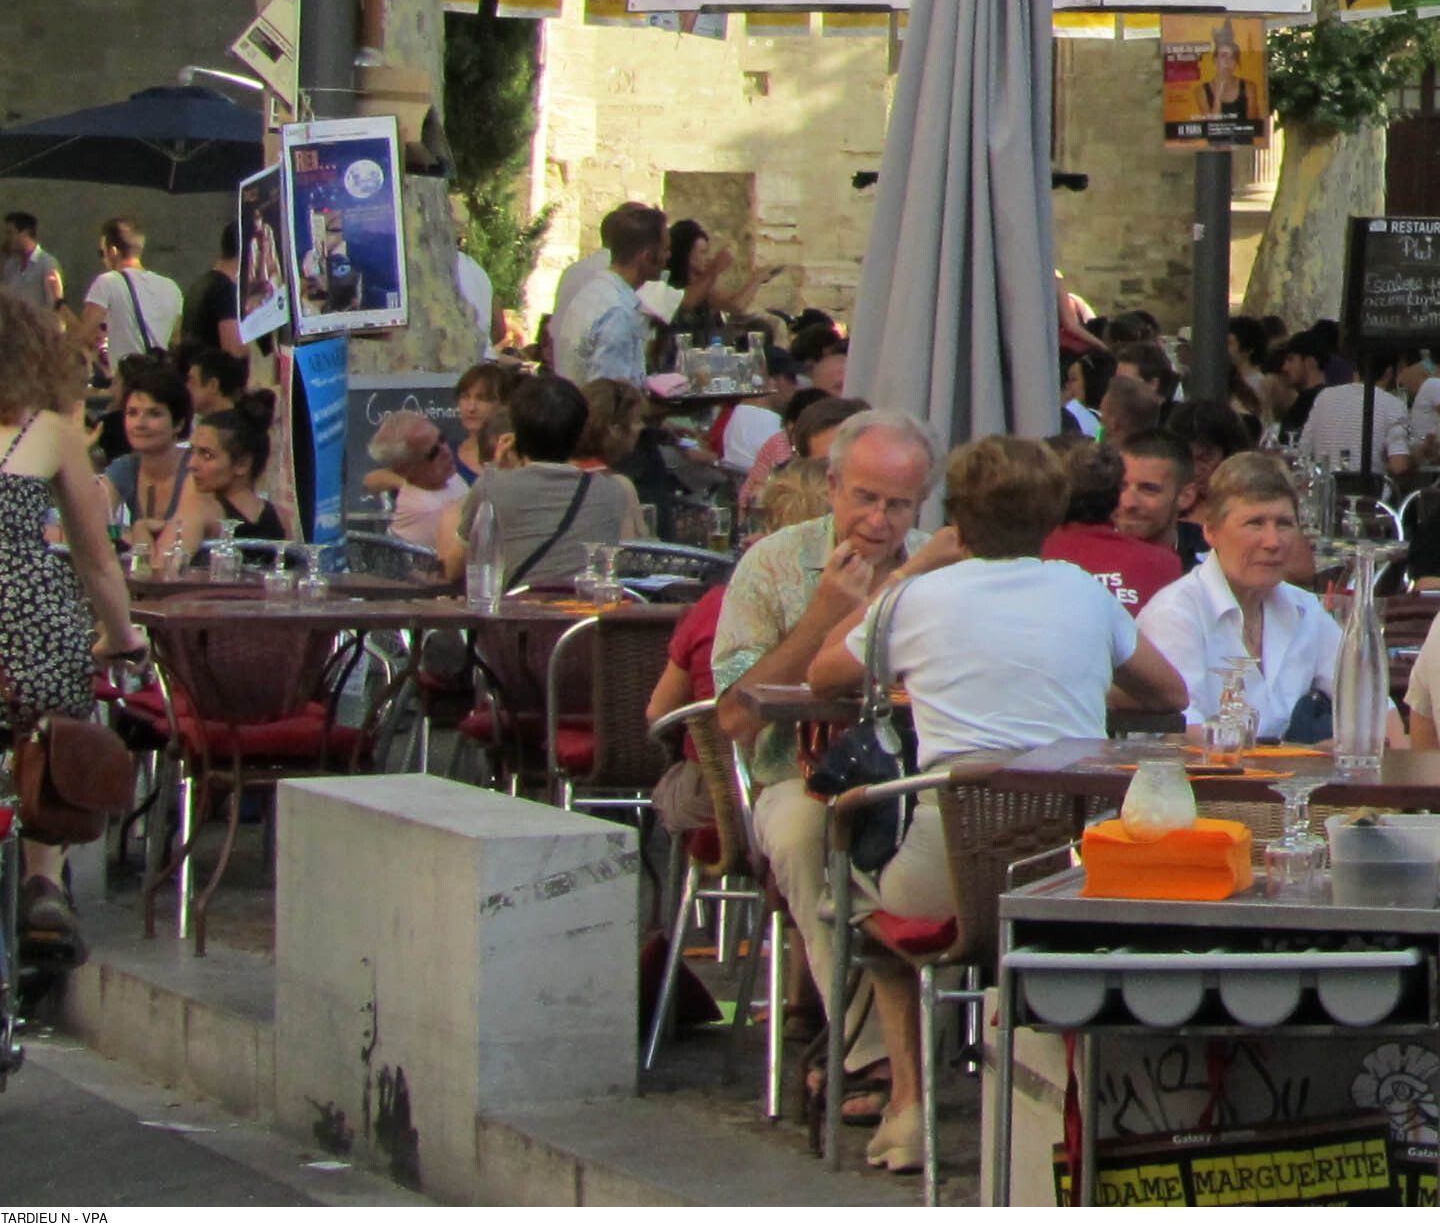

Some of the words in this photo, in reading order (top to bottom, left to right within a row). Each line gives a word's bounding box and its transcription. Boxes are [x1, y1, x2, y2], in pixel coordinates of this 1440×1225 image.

[1173, 1132, 1212, 1145] Galaxy
[1408, 1147, 1440, 1160] Gala
[1193, 1151, 1387, 1195] MARGUERITE
